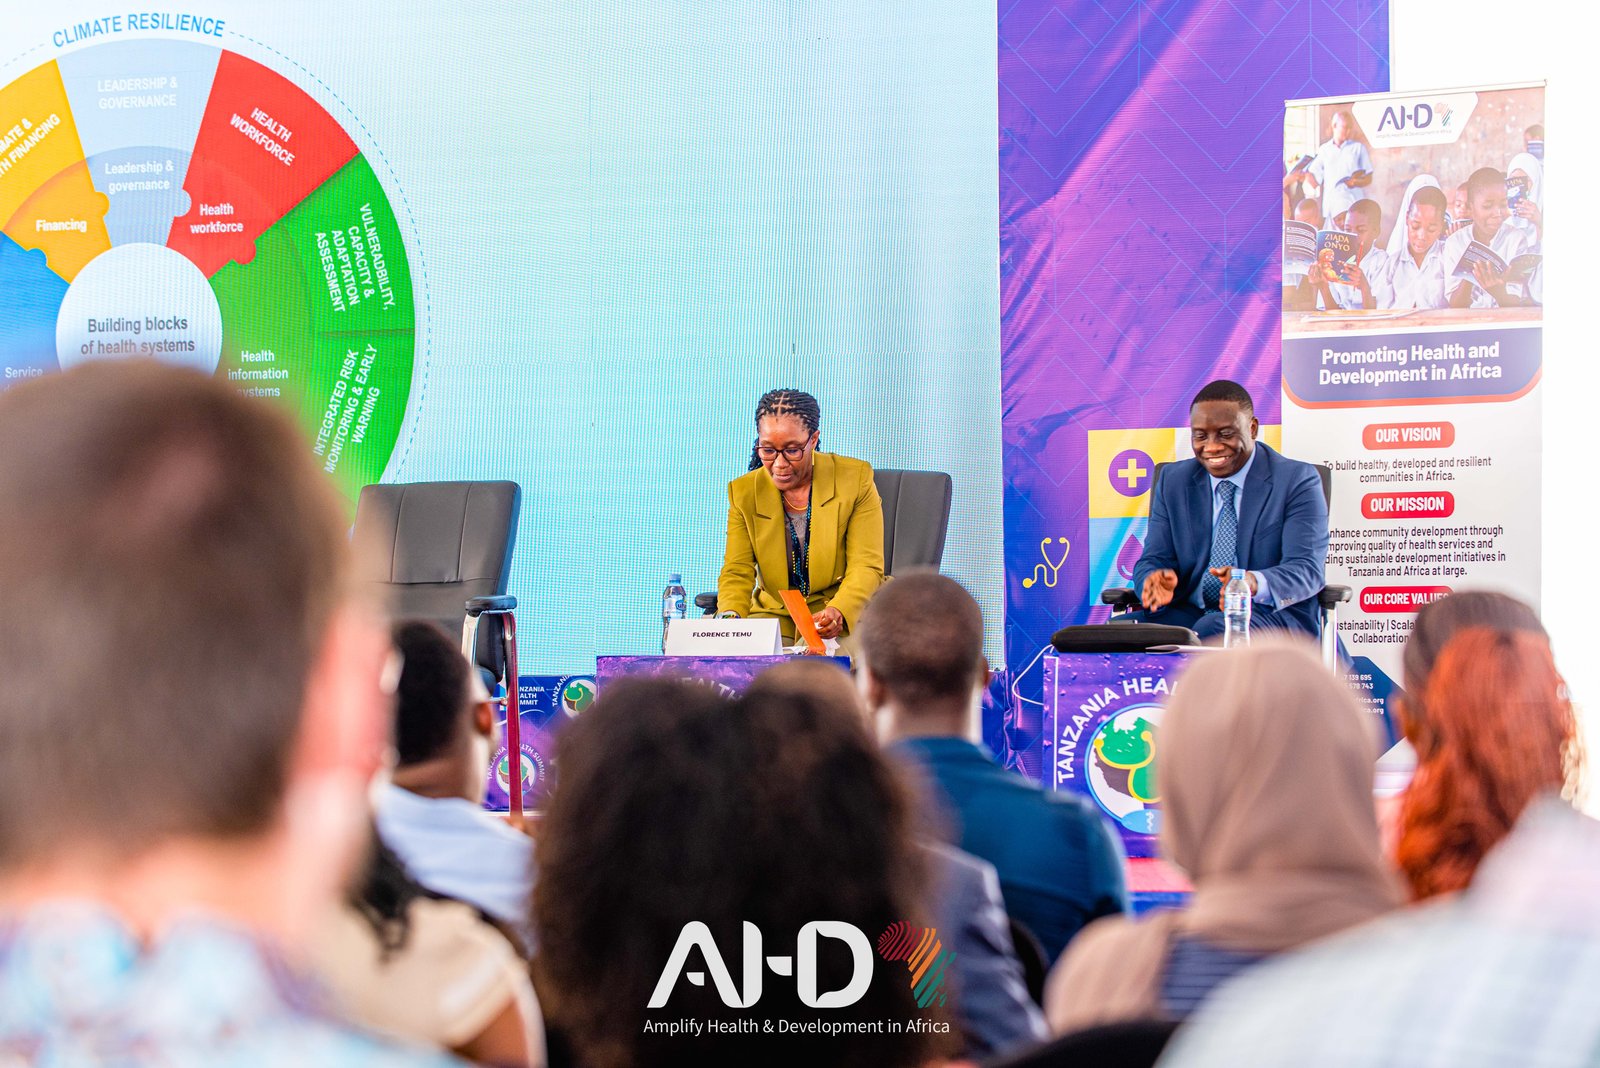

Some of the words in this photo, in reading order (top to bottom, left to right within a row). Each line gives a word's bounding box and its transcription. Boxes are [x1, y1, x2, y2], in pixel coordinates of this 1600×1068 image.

[52, 16, 122, 48] CLIMATE
[127, 13, 226, 38] RESILIENCE
[97, 77, 167, 93] LEADERSHIP
[170, 77, 178, 88] &
[98, 94, 177, 109] GOVERNANCE
[250, 107, 293, 143] HEALTH
[8, 113, 61, 164] FINANCING
[229, 113, 296, 167] WORKFORCE
[105, 161, 162, 177] Leadership
[165, 160, 174, 172] &
[108, 179, 170, 195] governance
[199, 202, 234, 217] Health
[35, 219, 87, 233] Financing
[190, 219, 244, 234] workforce
[1324, 241, 1350, 251] ONYO
[1325, 233, 1349, 243] ZIADA
[348, 226, 373, 285] CAPACITY
[363, 288, 375, 298] &
[360, 203, 395, 310] VULNERADBILITY,
[315, 232, 345, 312] ASSESSMENT
[332, 230, 360, 305] ADAPTATION
[88, 318, 141, 334] Building
[145, 316, 188, 331] blocks
[81, 340, 95, 354] of
[97, 339, 137, 354] health
[141, 339, 195, 356] systems
[1322, 346, 1408, 365] Promoting
[1411, 343, 1465, 362] Health
[1468, 341, 1500, 358] and
[241, 350, 275, 362] Health
[355, 343, 377, 385] EARLY
[5, 366, 43, 379] Service
[228, 367, 289, 380] information
[1319, 365, 1427, 387] Development
[1431, 364, 1447, 380] in
[1450, 362, 1502, 379] Africa
[352, 386, 363, 396] &
[313, 380, 347, 456] INTEGRATED
[340, 349, 359, 379] RISK
[351, 386, 380, 444] WARNING
[324, 397, 359, 474] MONITORING
[1375, 428, 1399, 443] OUR
[1402, 427, 1441, 442] VISION
[1323, 460, 1333, 471] To
[1335, 459, 1357, 471] build
[1358, 458, 1391, 472] healthy,
[1392, 458, 1437, 472] developed
[1439, 457, 1455, 468] and
[1456, 456, 1491, 467] resilient
[1359, 471, 1414, 483] communities
[1415, 471, 1424, 482] in
[1426, 470, 1455, 482] Africa.
[1370, 499, 1394, 512] OUR
[1396, 496, 1445, 511] MISSION
[1328, 528, 1360, 538] nhance
[1362, 526, 1409, 539] community
[1411, 525, 1468, 538] development
[1469, 525, 1503, 537] through
[1328, 541, 1366, 553] mproving
[1368, 540, 1397, 552] quality
[1398, 540, 1408, 550] of
[1409, 539, 1437, 549] health
[1438, 539, 1476, 549] services
[1477, 538, 1493, 549] and
[1325, 554, 1344, 566] ding
[1345, 553, 1393, 564] sustainable
[1395, 552, 1452, 565] development
[1453, 551, 1496, 562] initiatives
[1498, 551, 1506, 561] in
[1348, 566, 1384, 577] Tanzania
[1386, 566, 1402, 576] and
[1403, 565, 1430, 576] Africa
[1432, 566, 1441, 576] at
[1443, 565, 1468, 577] large.
[1364, 594, 1383, 605] OUR
[1384, 593, 1410, 604] CORE
[1337, 620, 1385, 632] stainability
[1391, 619, 1416, 631] Scala
[1057, 687, 1120, 783] TANZANIA
